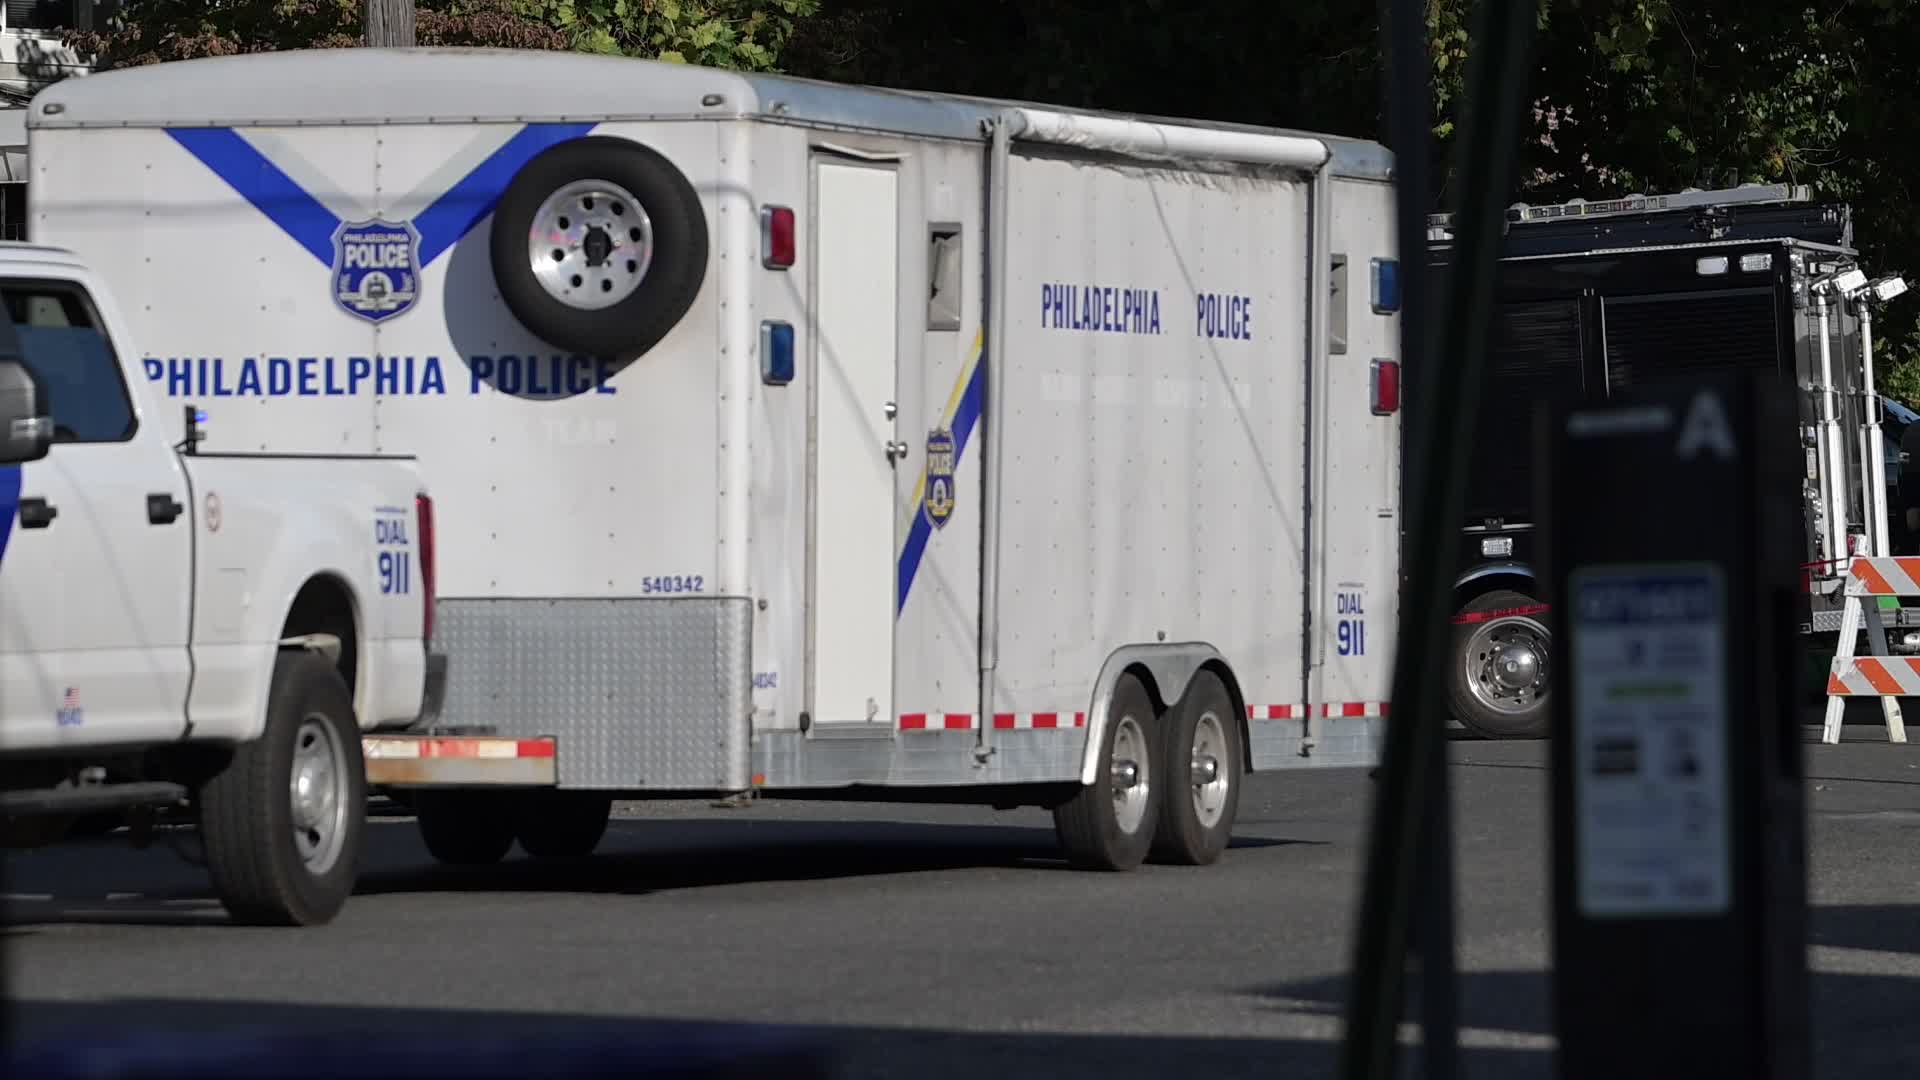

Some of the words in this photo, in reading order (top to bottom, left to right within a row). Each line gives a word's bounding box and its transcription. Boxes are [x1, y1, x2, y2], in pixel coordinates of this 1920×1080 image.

[344, 243, 409, 268] POLICE
[1041, 283, 1160, 335] PHILADELPHIA
[1197, 293, 1251, 340] POLICE
[142, 356, 445, 396] PHILADELPHIA
[470, 355, 617, 395] POLICE
[376, 519, 408, 545] DIAL
[379, 551, 409, 594] 911
[642, 575, 704, 593] 540342
[1337, 592, 1364, 615] DIAL
[1337, 619, 1364, 656] 911
